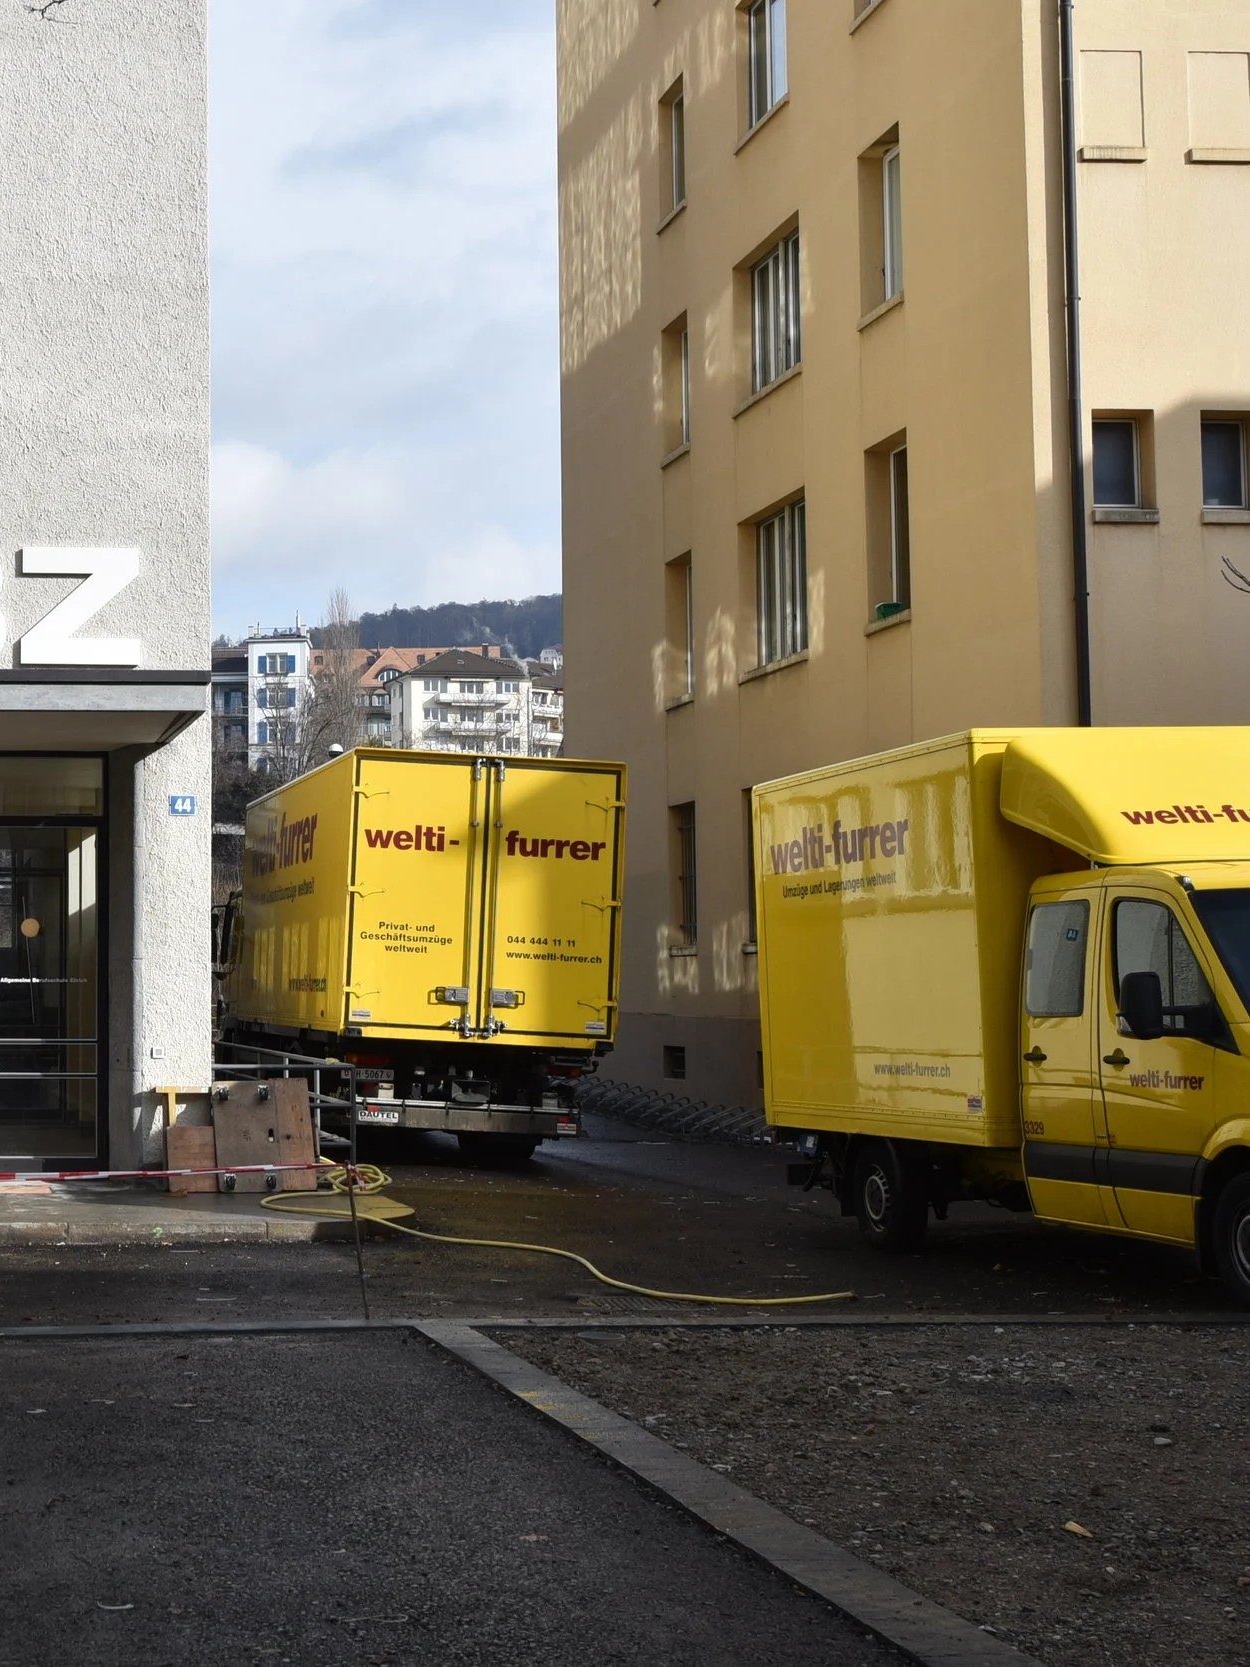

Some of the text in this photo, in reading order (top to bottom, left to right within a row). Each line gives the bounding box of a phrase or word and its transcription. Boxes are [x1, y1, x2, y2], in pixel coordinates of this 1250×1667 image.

[174, 798, 192, 813] 44
[505, 830, 606, 861] furrer
[770, 818, 909, 875] welti-furrer
[782, 870, 897, 899] Umzüge und Lagerungen weltweit
[378, 921, 435, 932] Privat- und
[360, 931, 453, 946] Geschäftsumzüge
[507, 935, 576, 947] 044 444 11 11
[384, 944, 428, 954] weltweit
[506, 951, 603, 964] www.welti-furrer.ch
[873, 1062, 951, 1078] www.welti-furrer.ch
[1129, 1069, 1205, 1091] welti-furrer
[359, 1111, 398, 1119] DAUTEL
[1024, 1120, 1045, 1136] 3329
